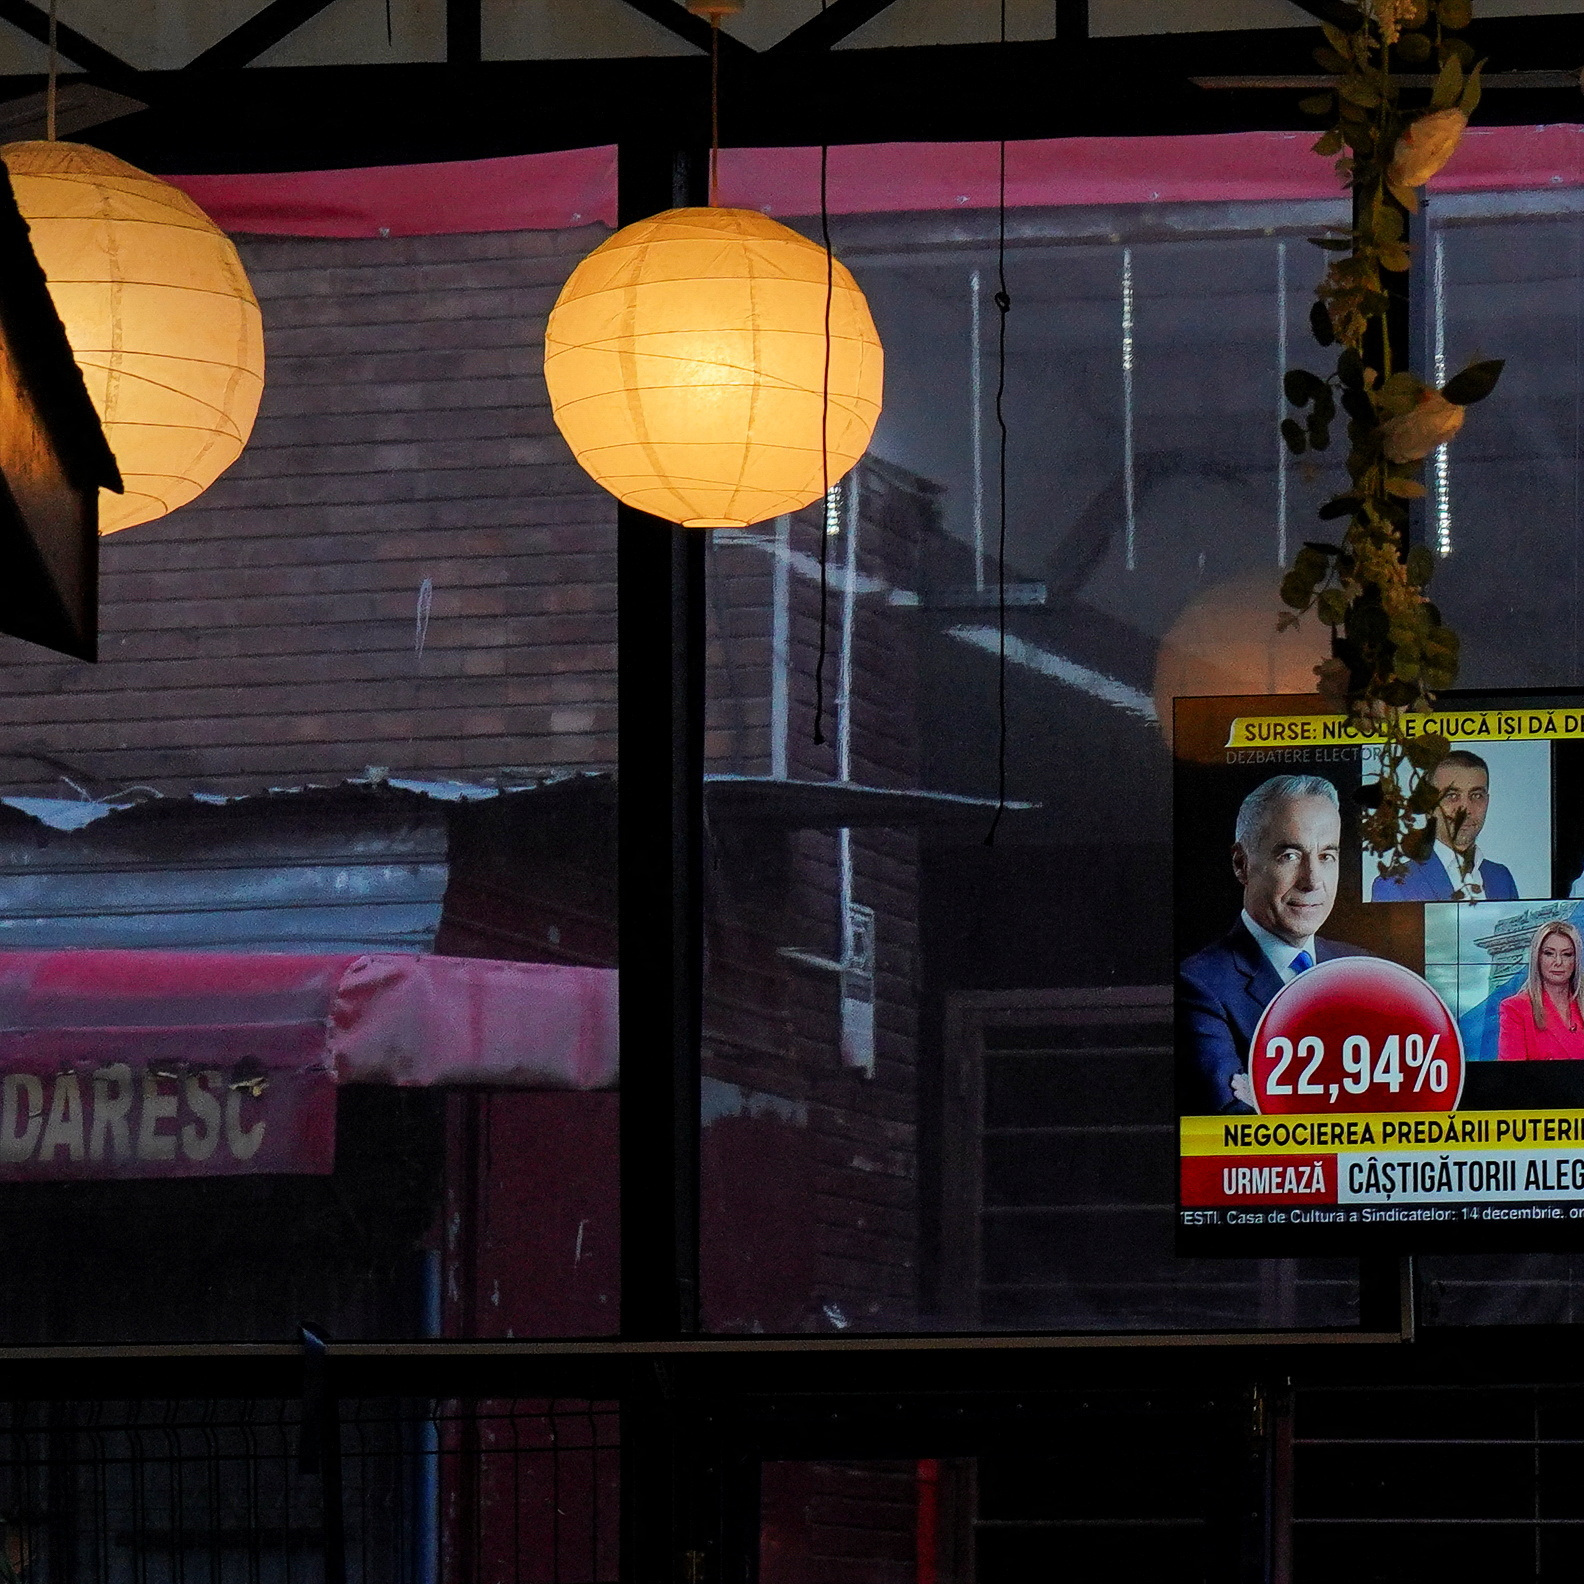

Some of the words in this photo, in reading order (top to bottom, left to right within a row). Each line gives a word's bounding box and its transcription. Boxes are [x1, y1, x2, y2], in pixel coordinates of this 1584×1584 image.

[1244, 721, 1317, 742] SURSE:
[1422, 712, 1491, 737] CIUCĂ
[1497, 711, 1522, 741] ÎȘI
[1528, 710, 1558, 734] DĂ
[1226, 747, 1311, 765] DEZBATERE
[1265, 1033, 1449, 1104] 22,94%
[1223, 1121, 1375, 1147] NEGOCIEREA
[1382, 1114, 1489, 1144] PREDĂRII
[1223, 1160, 1326, 1195] URMEAZĂ
[1348, 1154, 1516, 1201] CÂȘTIGĂTORII
[1226, 1210, 1264, 1225] Casa
[1268, 1210, 1286, 1224] de
[1290, 1209, 1345, 1224] Cultura
[1349, 1212, 1358, 1223] a
[1361, 1206, 1456, 1222] Sindicatelor:
[1461, 1207, 1478, 1221] 14
